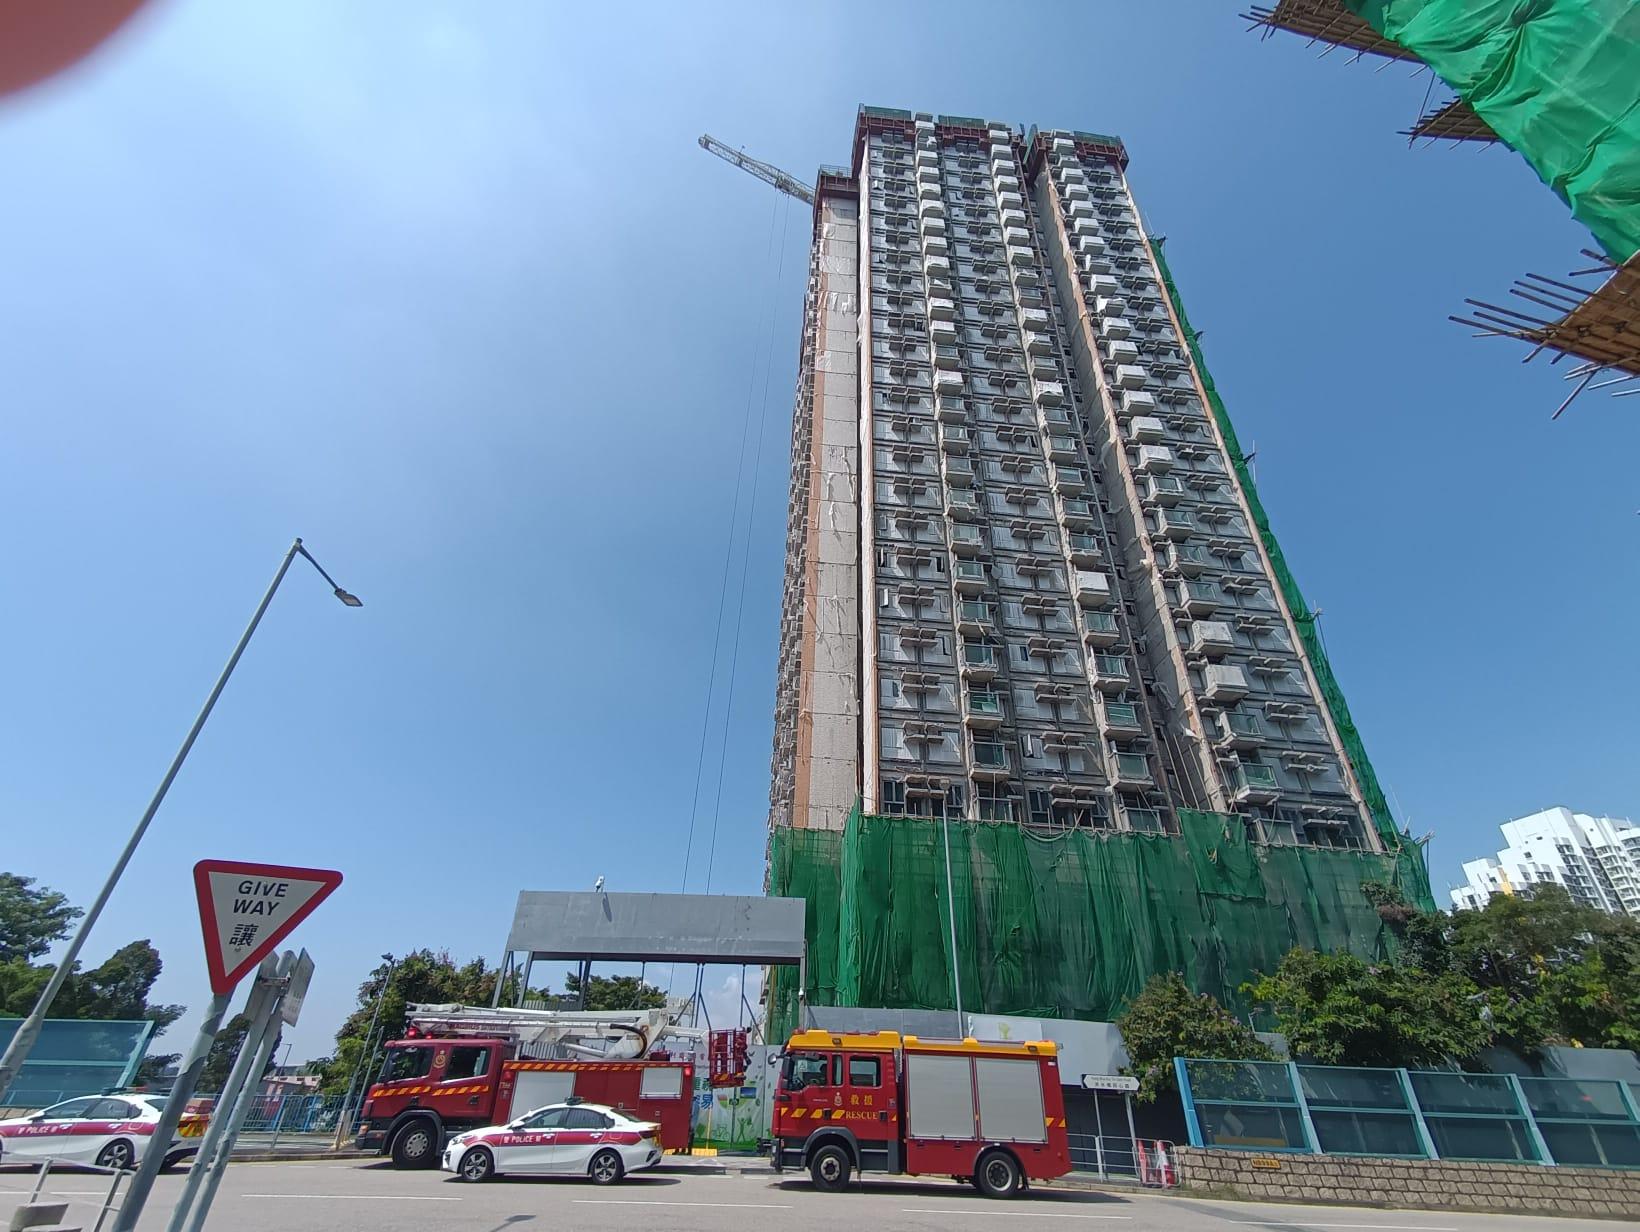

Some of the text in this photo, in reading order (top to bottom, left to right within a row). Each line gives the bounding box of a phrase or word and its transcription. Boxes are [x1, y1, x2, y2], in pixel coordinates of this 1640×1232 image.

[238, 880, 289, 898] GIVE
[233, 899, 280, 916] WAY
[229, 923, 259, 946] 讓
[845, 1110, 878, 1120] RESCUE
[511, 1135, 533, 1143] POLICE
